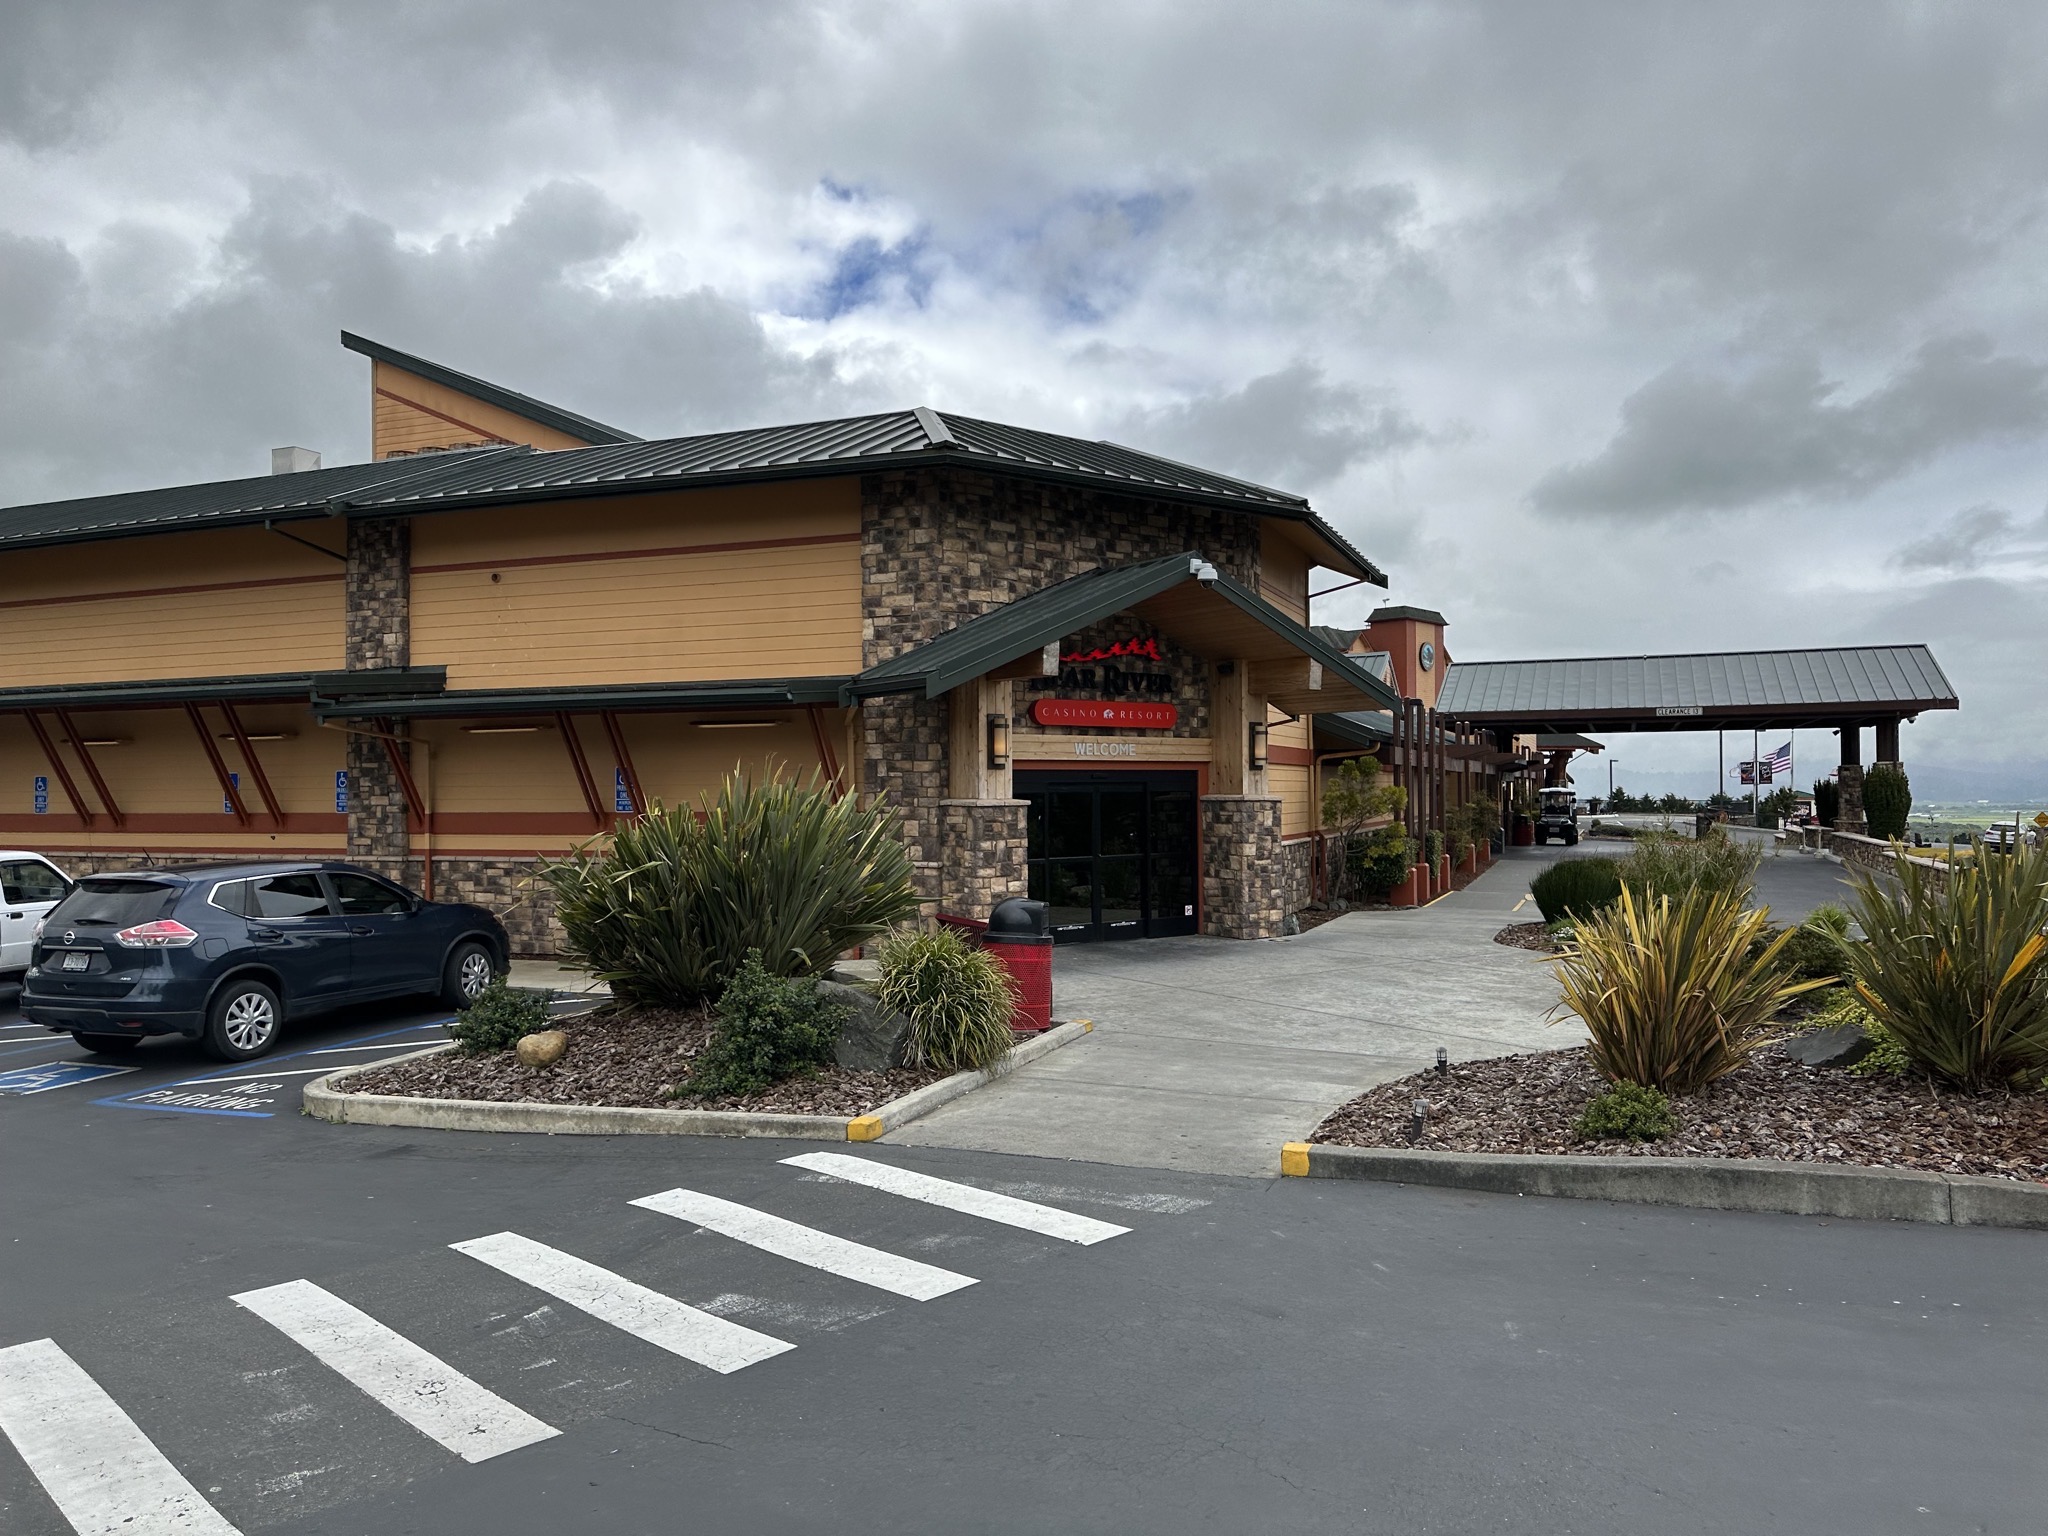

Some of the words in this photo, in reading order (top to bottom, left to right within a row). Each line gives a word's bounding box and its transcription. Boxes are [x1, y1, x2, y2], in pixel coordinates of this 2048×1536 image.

[1102, 664, 1174, 696] RIVER
[1042, 707, 1097, 719] CASINO
[1120, 710, 1171, 721] RESORT
[1074, 742, 1137, 757] WELCOME
[221, 1082, 283, 1094] NO
[127, 1090, 275, 1110] PARKING
